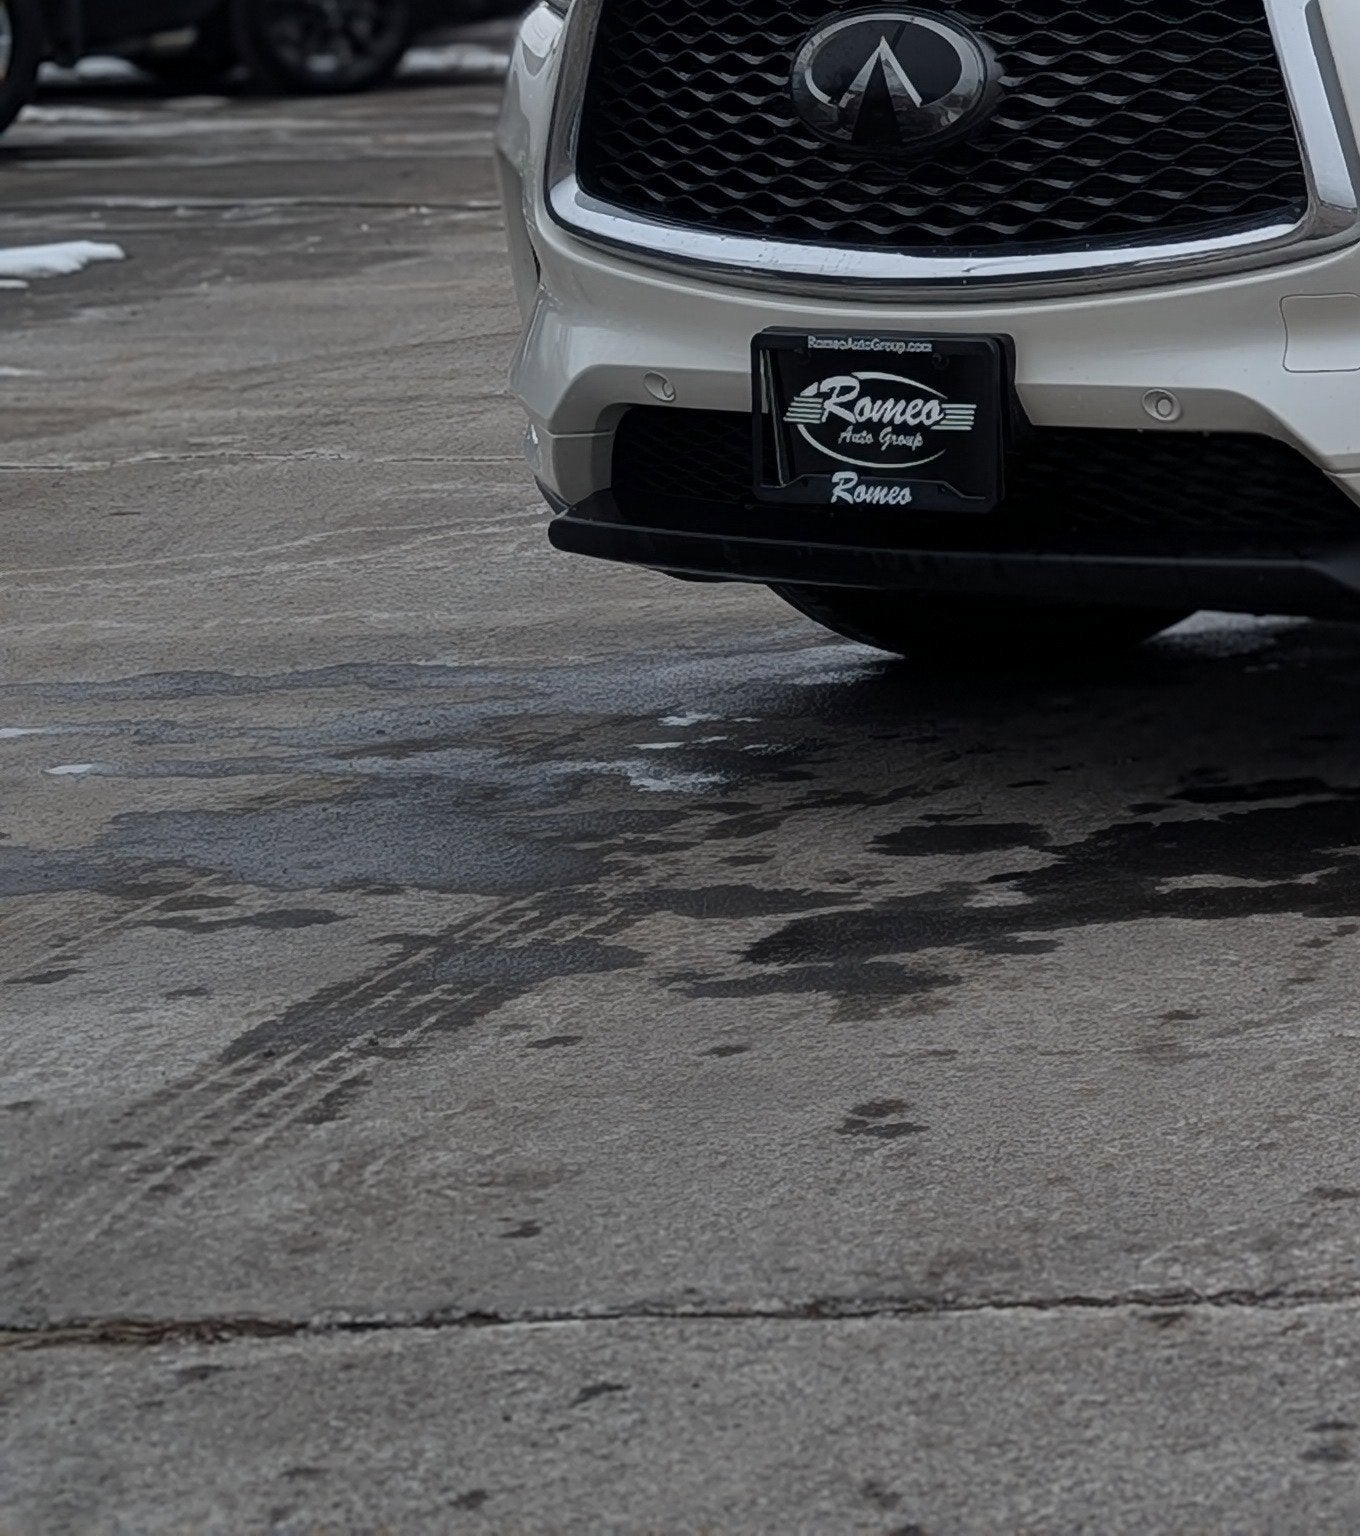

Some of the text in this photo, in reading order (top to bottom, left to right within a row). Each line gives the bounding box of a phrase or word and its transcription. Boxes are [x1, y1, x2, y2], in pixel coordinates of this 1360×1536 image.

[820, 375, 945, 425] Romeo
[838, 425, 924, 451] Auto Group
[831, 470, 912, 505] Romeo
